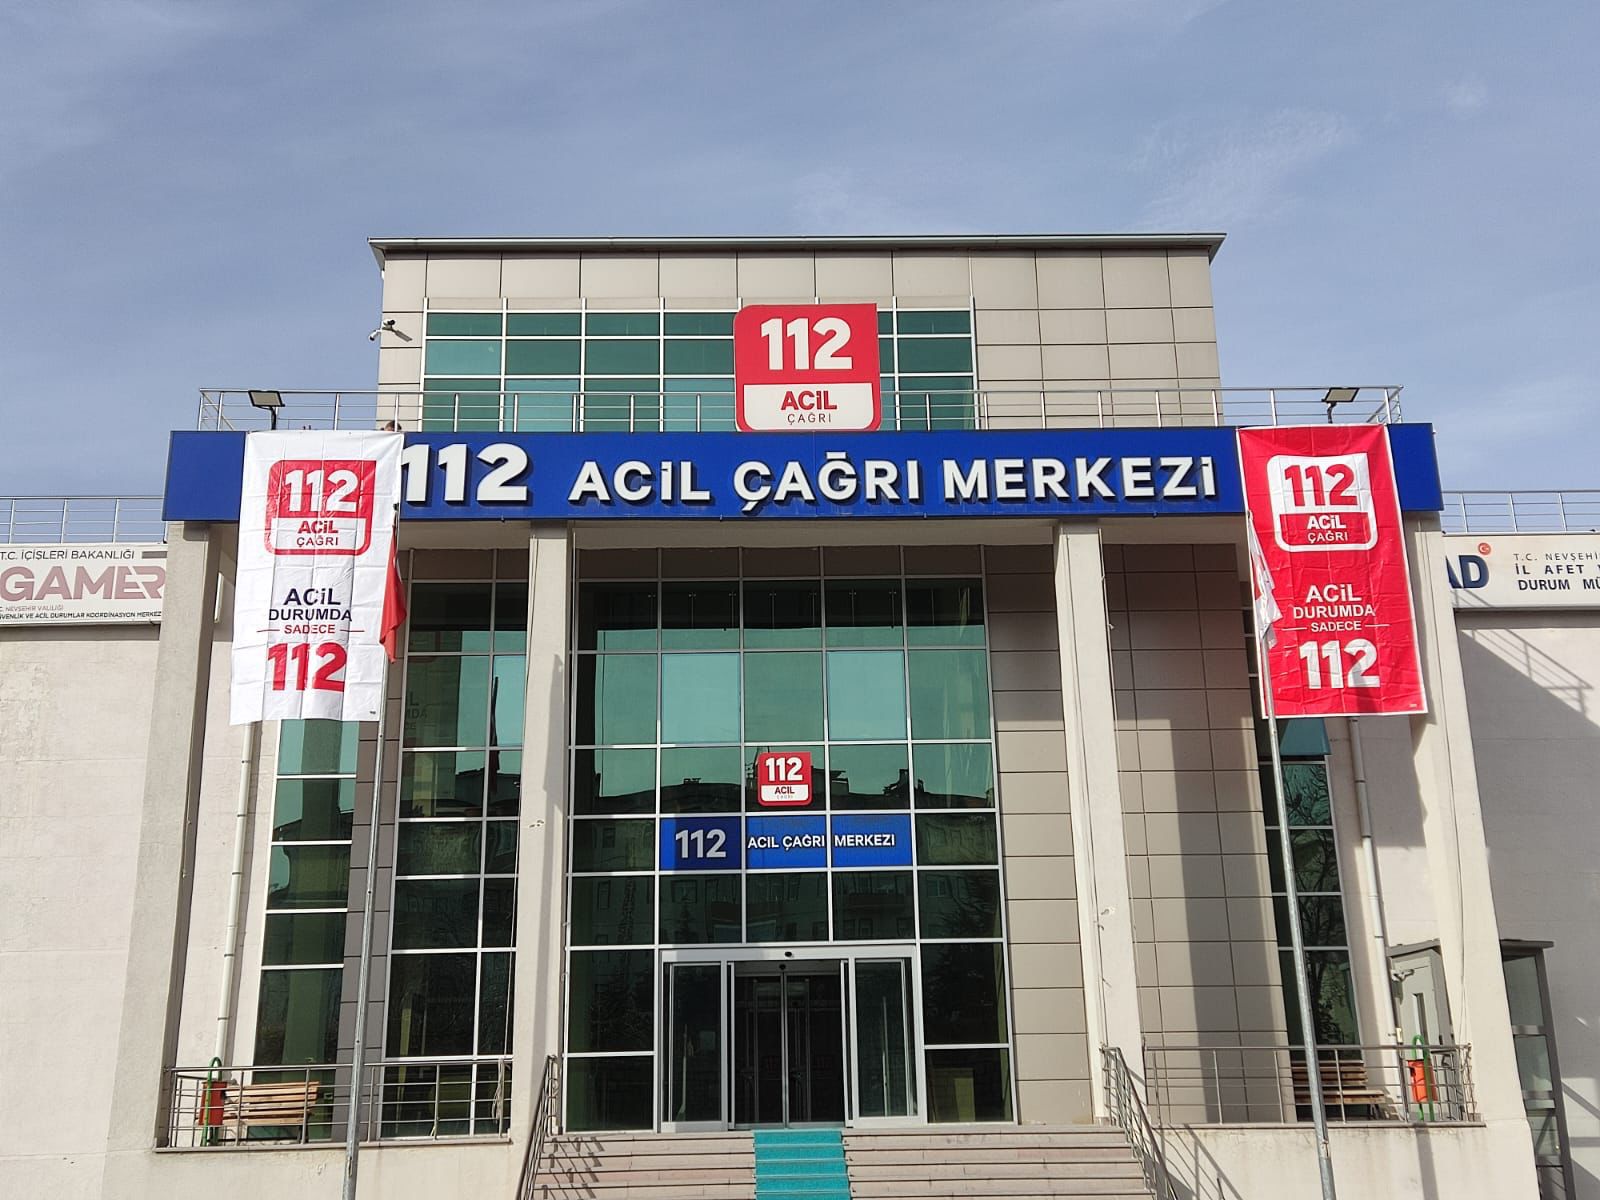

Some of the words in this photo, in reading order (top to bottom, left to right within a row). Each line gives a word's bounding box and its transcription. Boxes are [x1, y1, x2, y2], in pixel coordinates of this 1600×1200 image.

[761, 317, 853, 371] 112
[787, 412, 831, 425] ÇAĞRI
[401, 443, 528, 502] 112
[733, 452, 919, 512] ÇAĞRI
[1284, 463, 1358, 507] 112
[285, 469, 359, 513] 112
[296, 535, 339, 547] ÇAĞRI
[1307, 530, 1348, 544] ÇAĞRI
[21, 549, 68, 561] İÇİŞLERİ
[71, 549, 135, 560] BAKANLIĞI
[1513, 553, 1538, 561] T.C.
[1515, 563, 1531, 575] İL
[1544, 564, 1584, 575] AFET
[0, 566, 166, 601] GAMER
[1518, 578, 1570, 591] DURUM
[269, 608, 352, 621] DURUMDA
[1293, 604, 1376, 619] DURUMDA
[284, 624, 336, 634] SADECE
[1311, 621, 1362, 632] SADECE
[267, 642, 347, 693] 112
[1300, 638, 1380, 689] 112
[765, 757, 803, 782] 112
[675, 828, 727, 859] 112
[782, 834, 825, 851] ÇAĞRI
